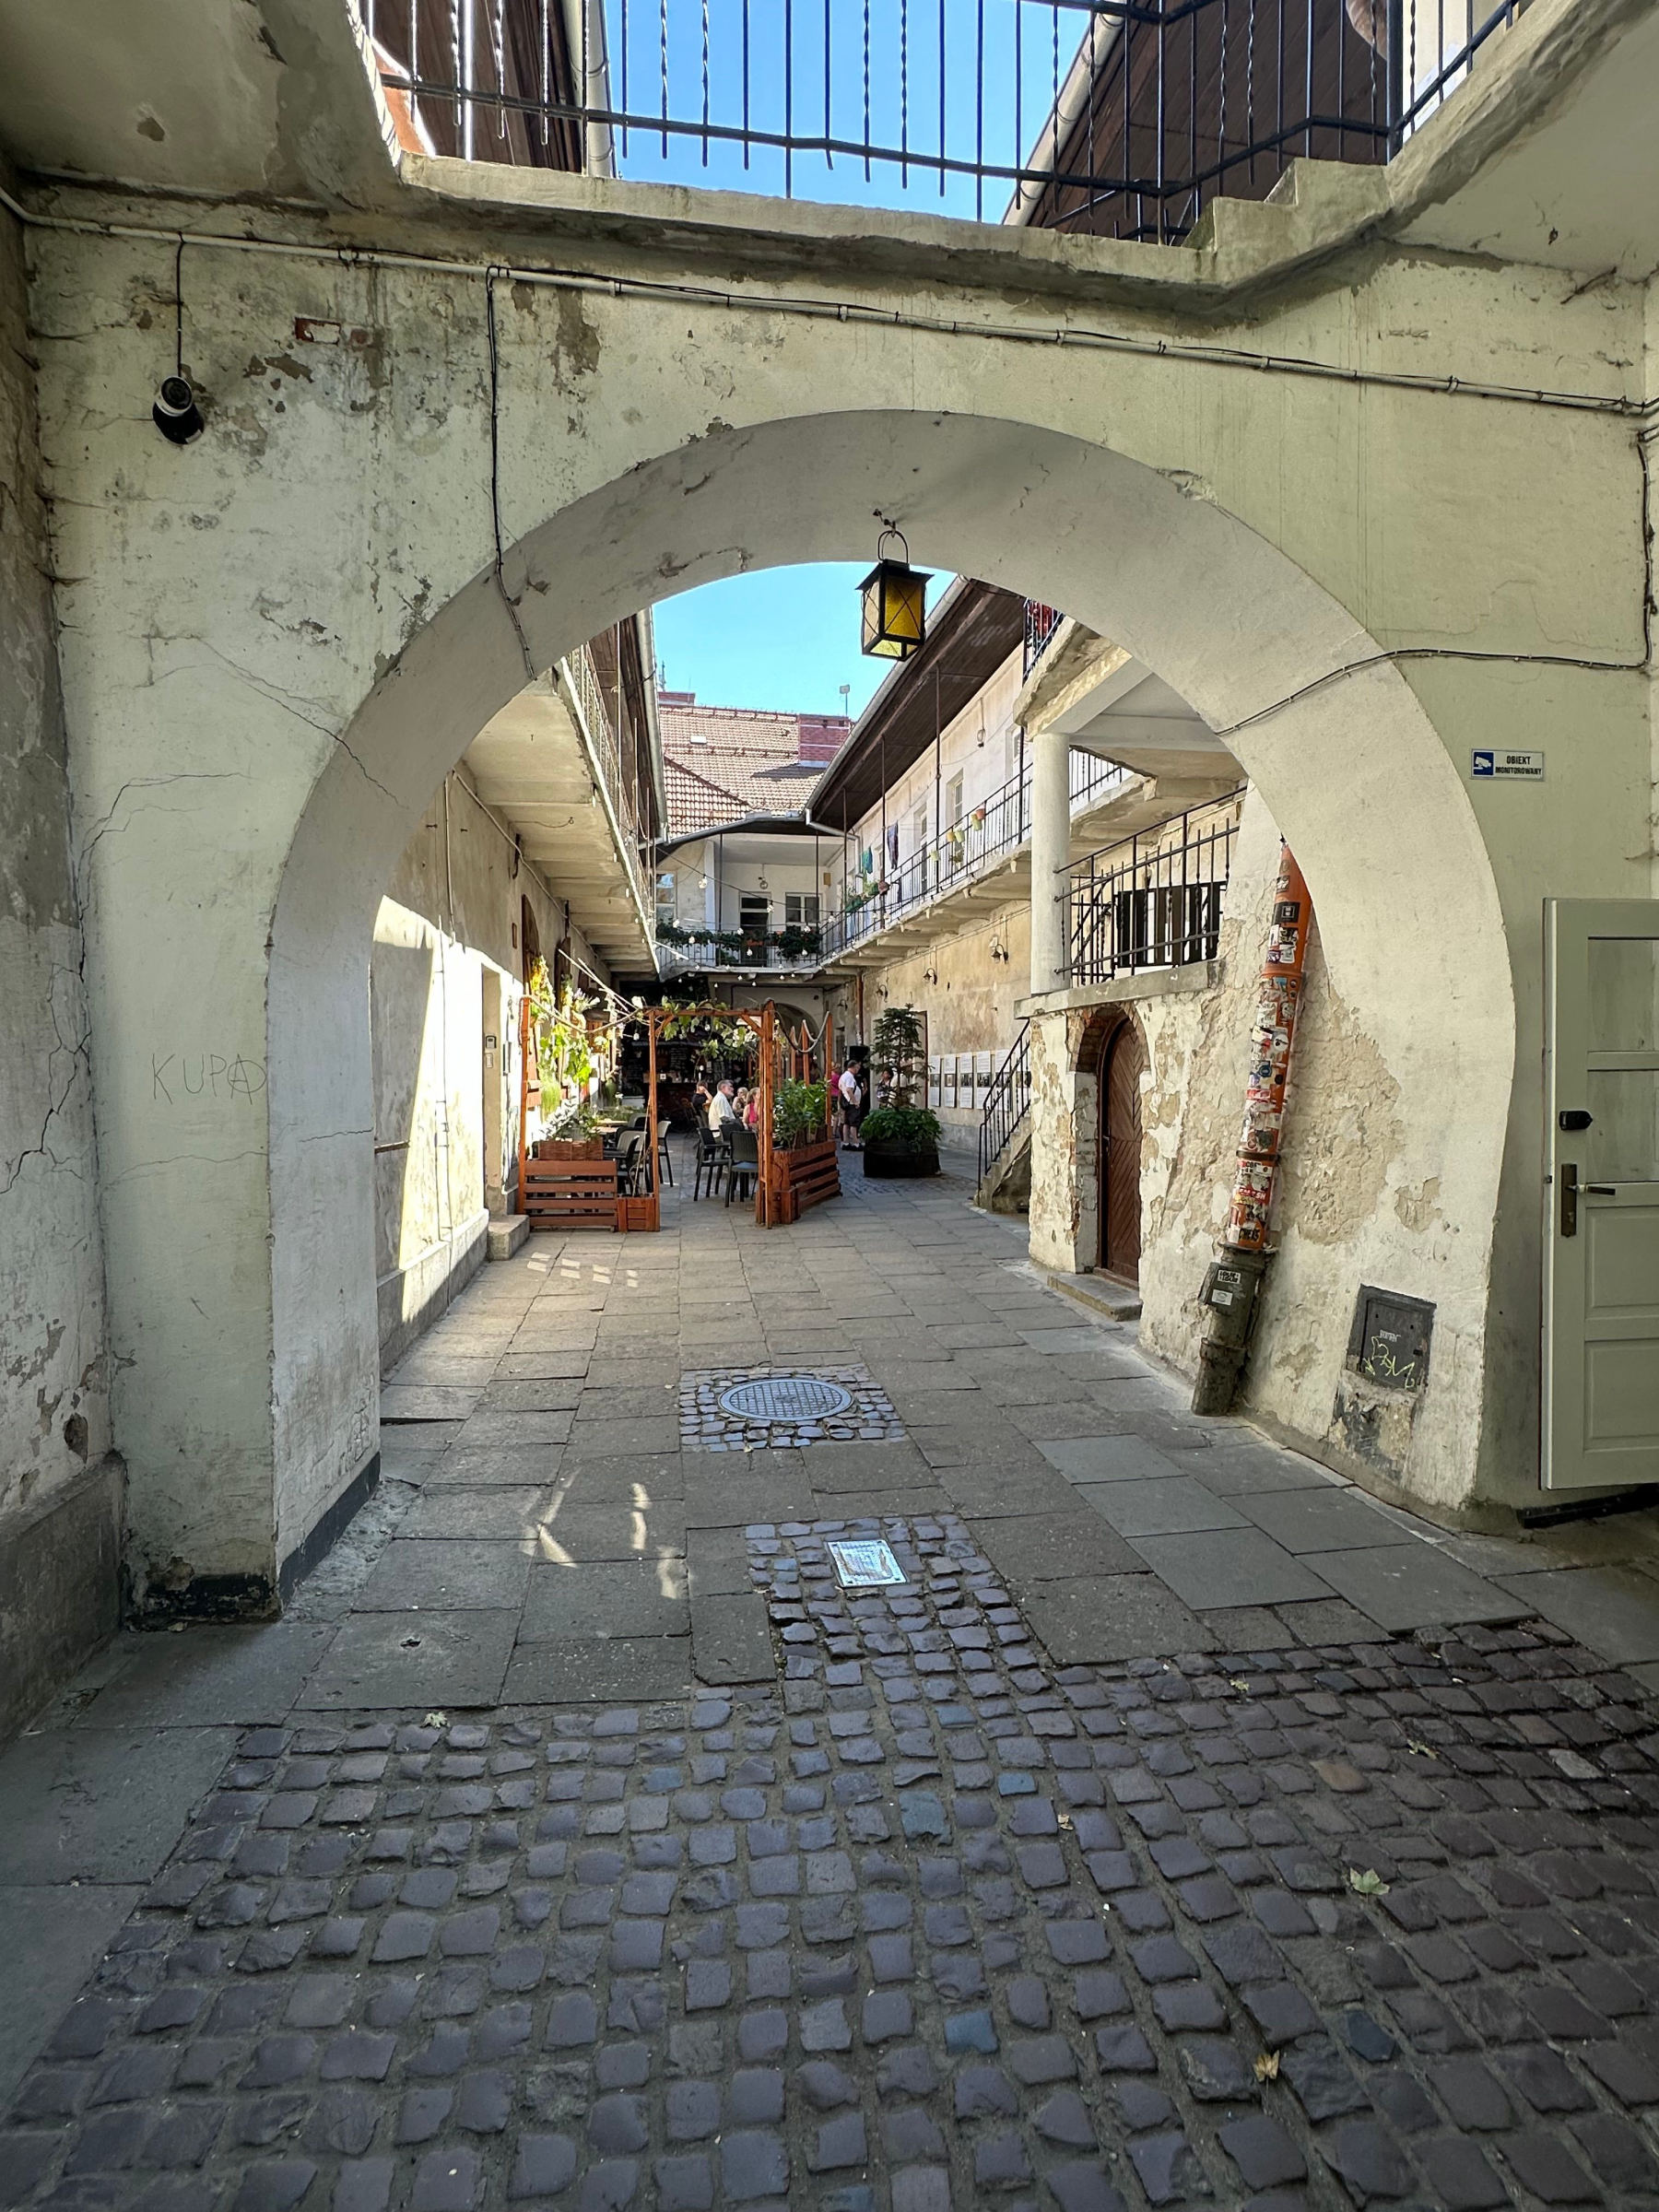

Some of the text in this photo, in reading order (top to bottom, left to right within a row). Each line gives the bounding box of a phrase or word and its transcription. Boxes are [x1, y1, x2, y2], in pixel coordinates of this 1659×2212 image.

[1506, 755, 1531, 765] OBIEKT
[1495, 767, 1542, 775] MONITOROWANY
[151, 1053, 267, 1105] KUPA
